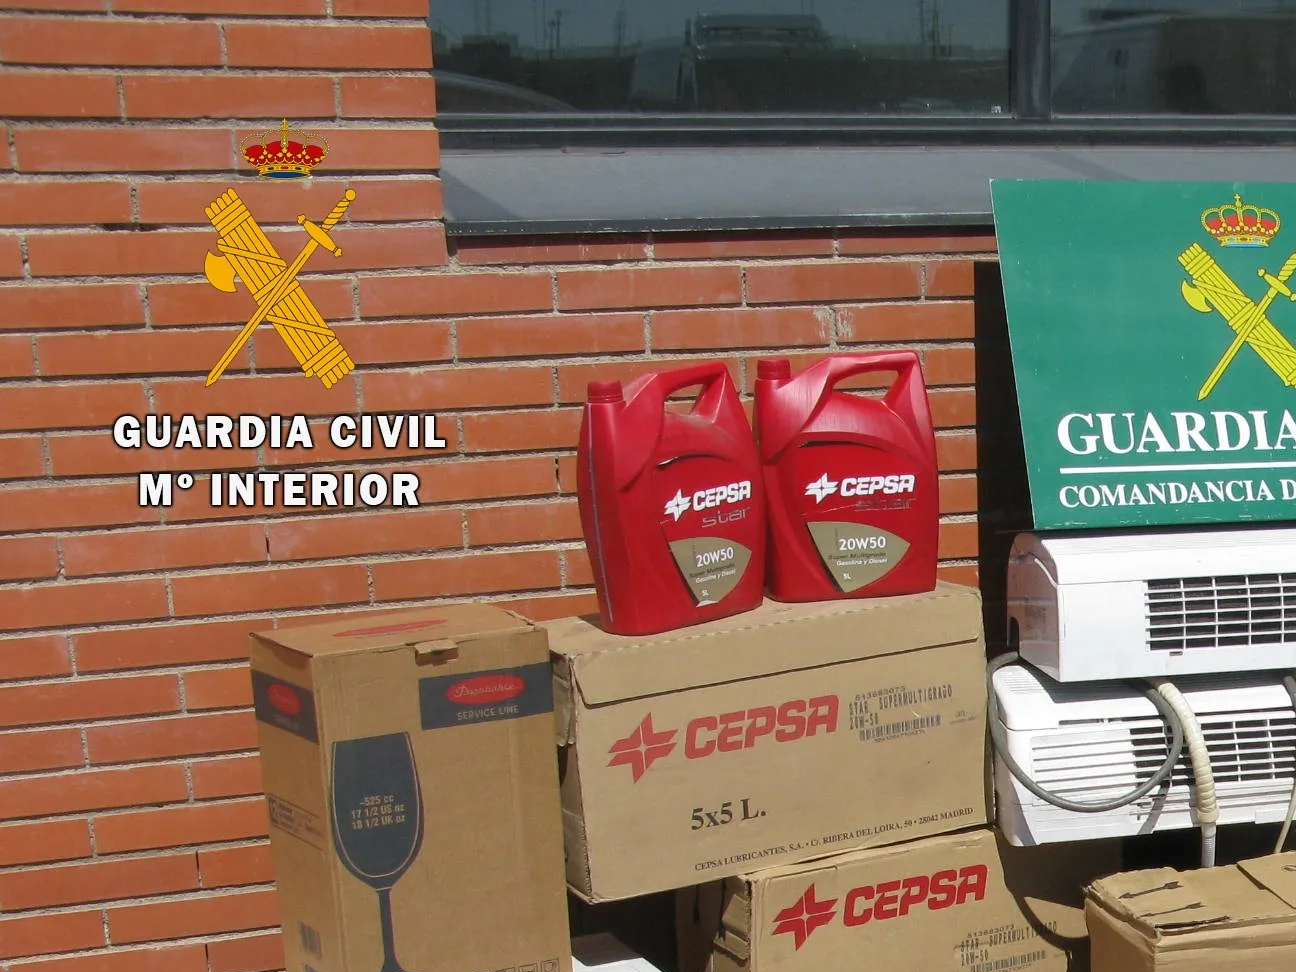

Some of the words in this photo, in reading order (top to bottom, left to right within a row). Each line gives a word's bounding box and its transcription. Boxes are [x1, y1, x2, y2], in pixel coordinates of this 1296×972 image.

[693, 480, 751, 511] CEPSA
[840, 474, 915, 497] CEPSA
[1059, 479, 1270, 509] COMANDANCIA
[695, 546, 734, 568] 20W50
[839, 536, 886, 551] 20W50
[456, 707, 497, 721] SERVICE
[499, 704, 520, 715] LINE
[684, 694, 840, 760] CEPSA
[691, 801, 734, 832] 5x5
[740, 797, 767, 820] L.
[695, 858, 723, 872] CEPSA
[724, 846, 788, 866] LUBRICANTES,
[822, 832, 855, 846] RIBERA
[855, 828, 874, 839] DEL
[874, 821, 903, 836] LOIRA,
[940, 806, 974, 821] MADRID
[843, 863, 988, 928] CEPSA
